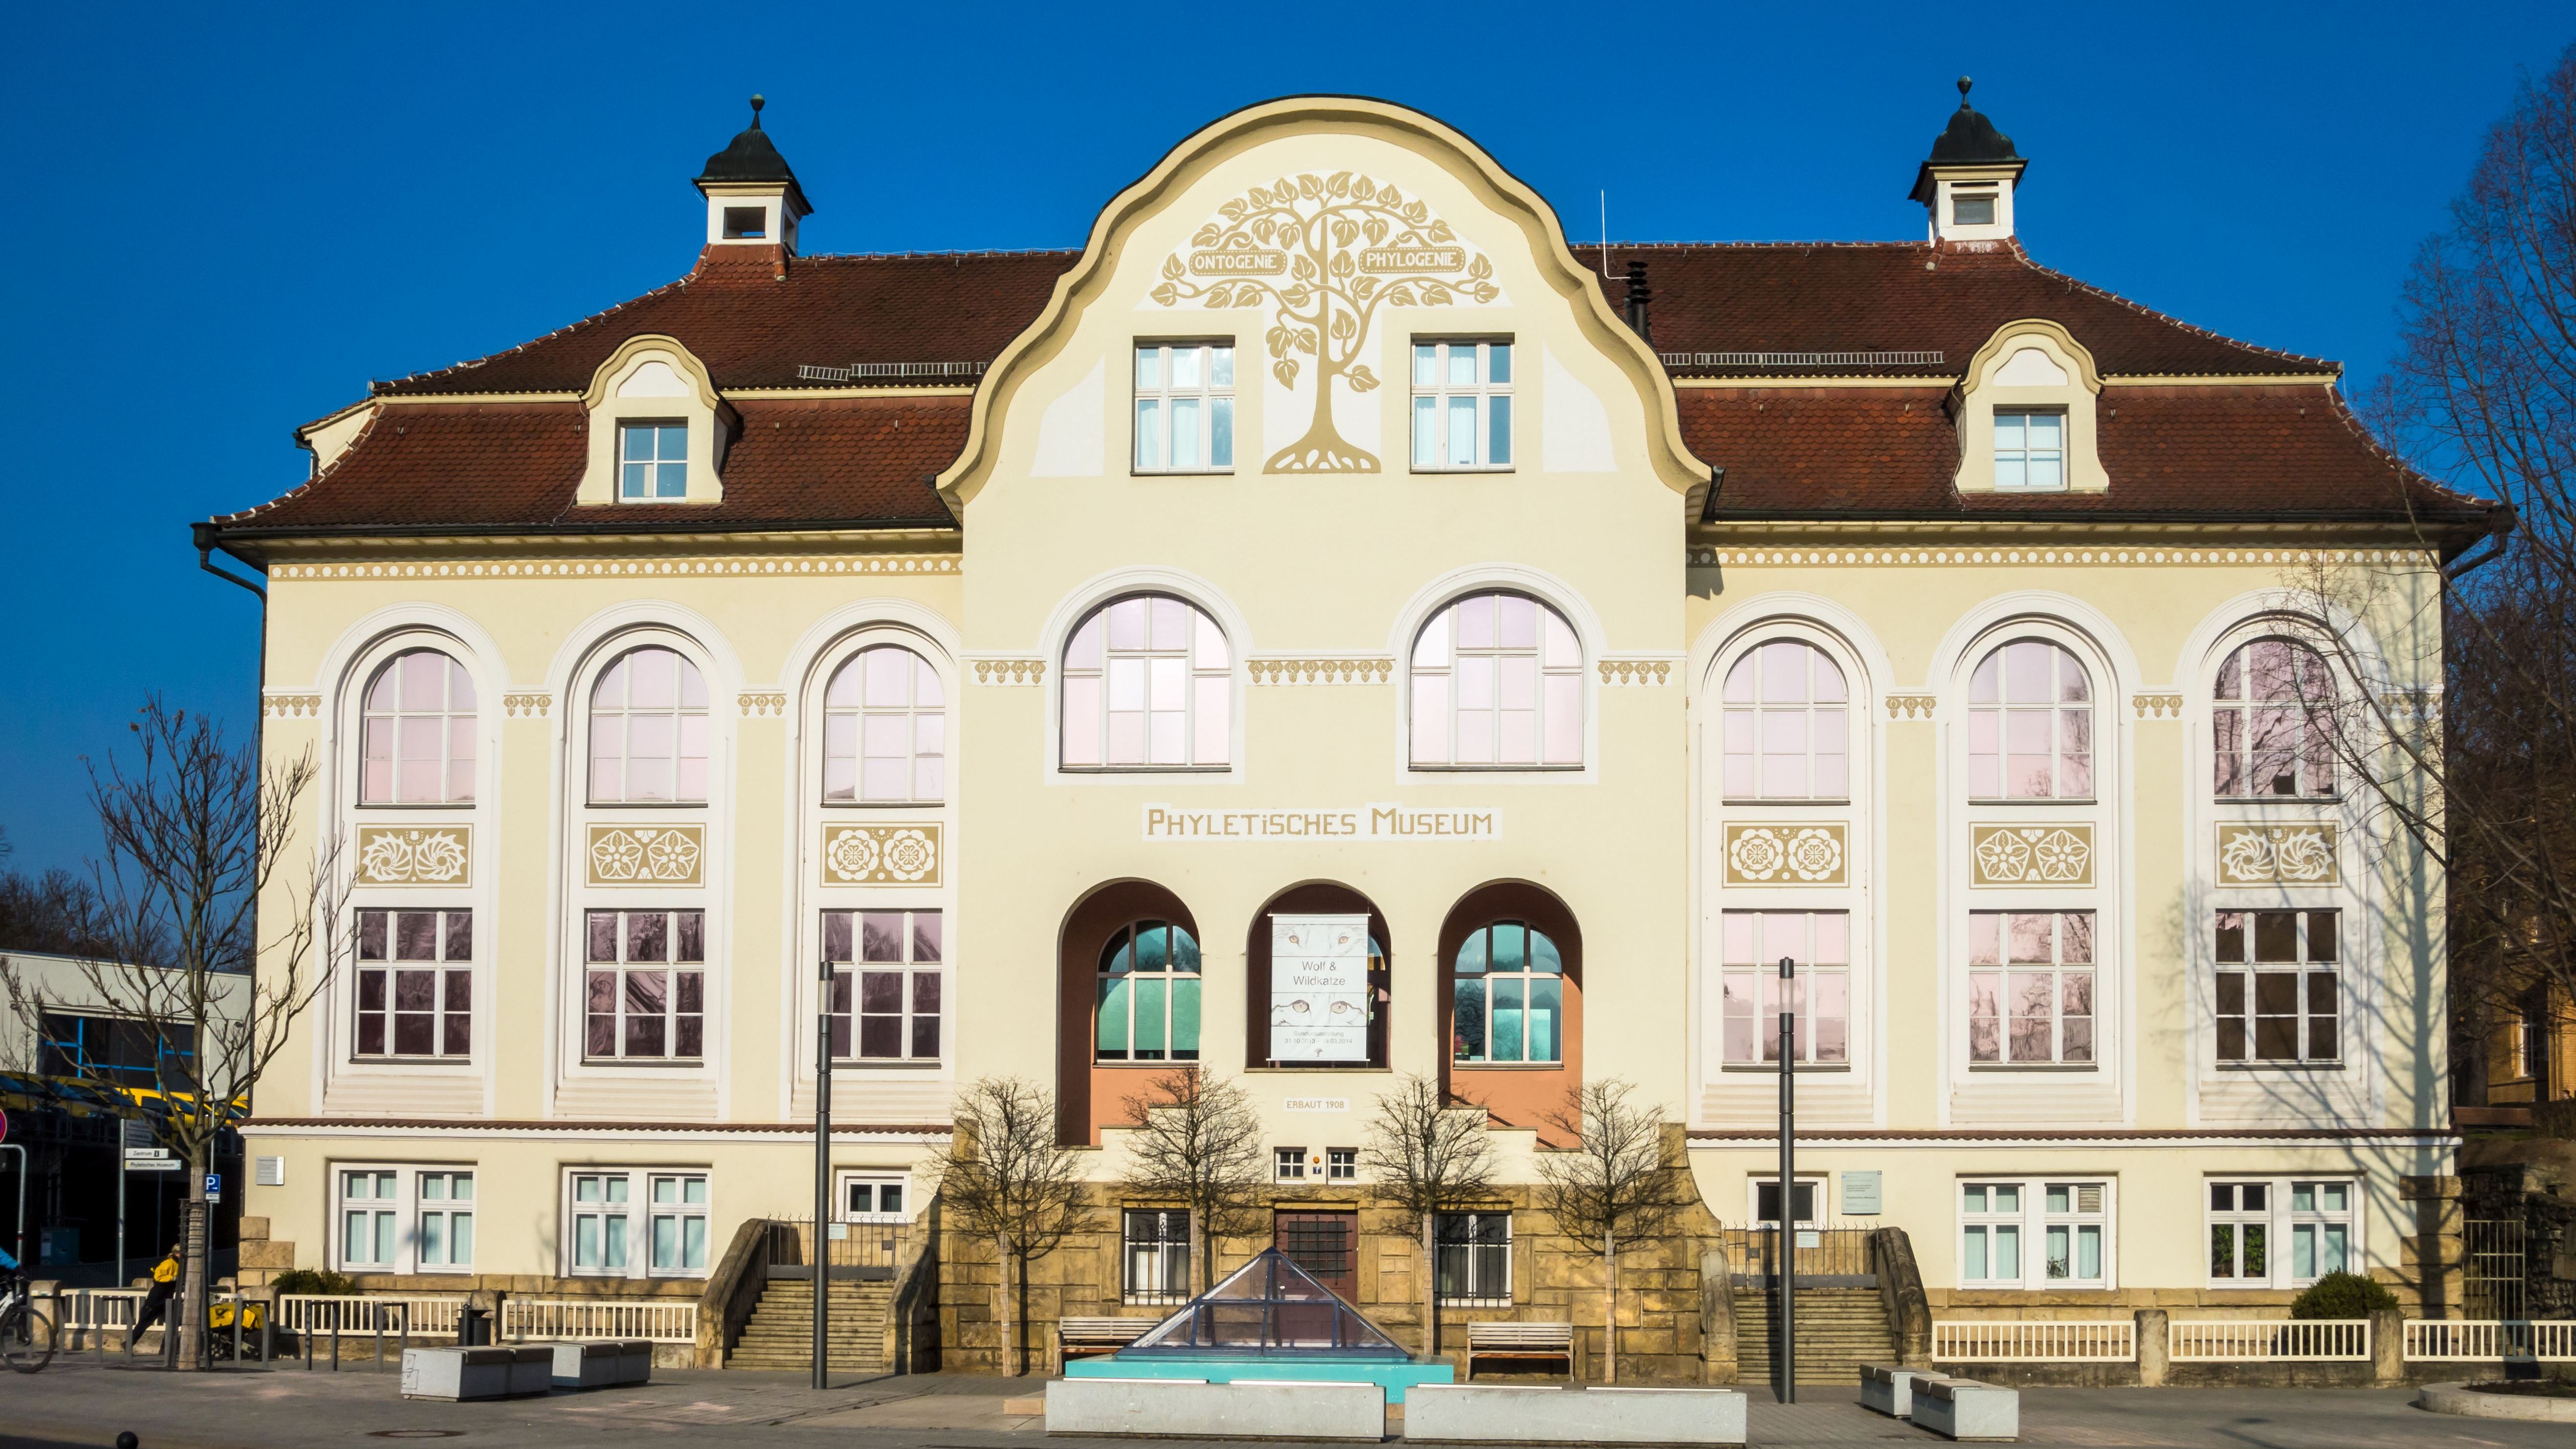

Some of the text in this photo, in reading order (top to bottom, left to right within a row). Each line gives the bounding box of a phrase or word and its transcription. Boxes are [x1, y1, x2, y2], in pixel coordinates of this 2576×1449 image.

[1302, 961, 1337, 971] Wolf &
[1293, 976, 1345, 985] Wildkatze
[206, 1177, 216, 1190] P
